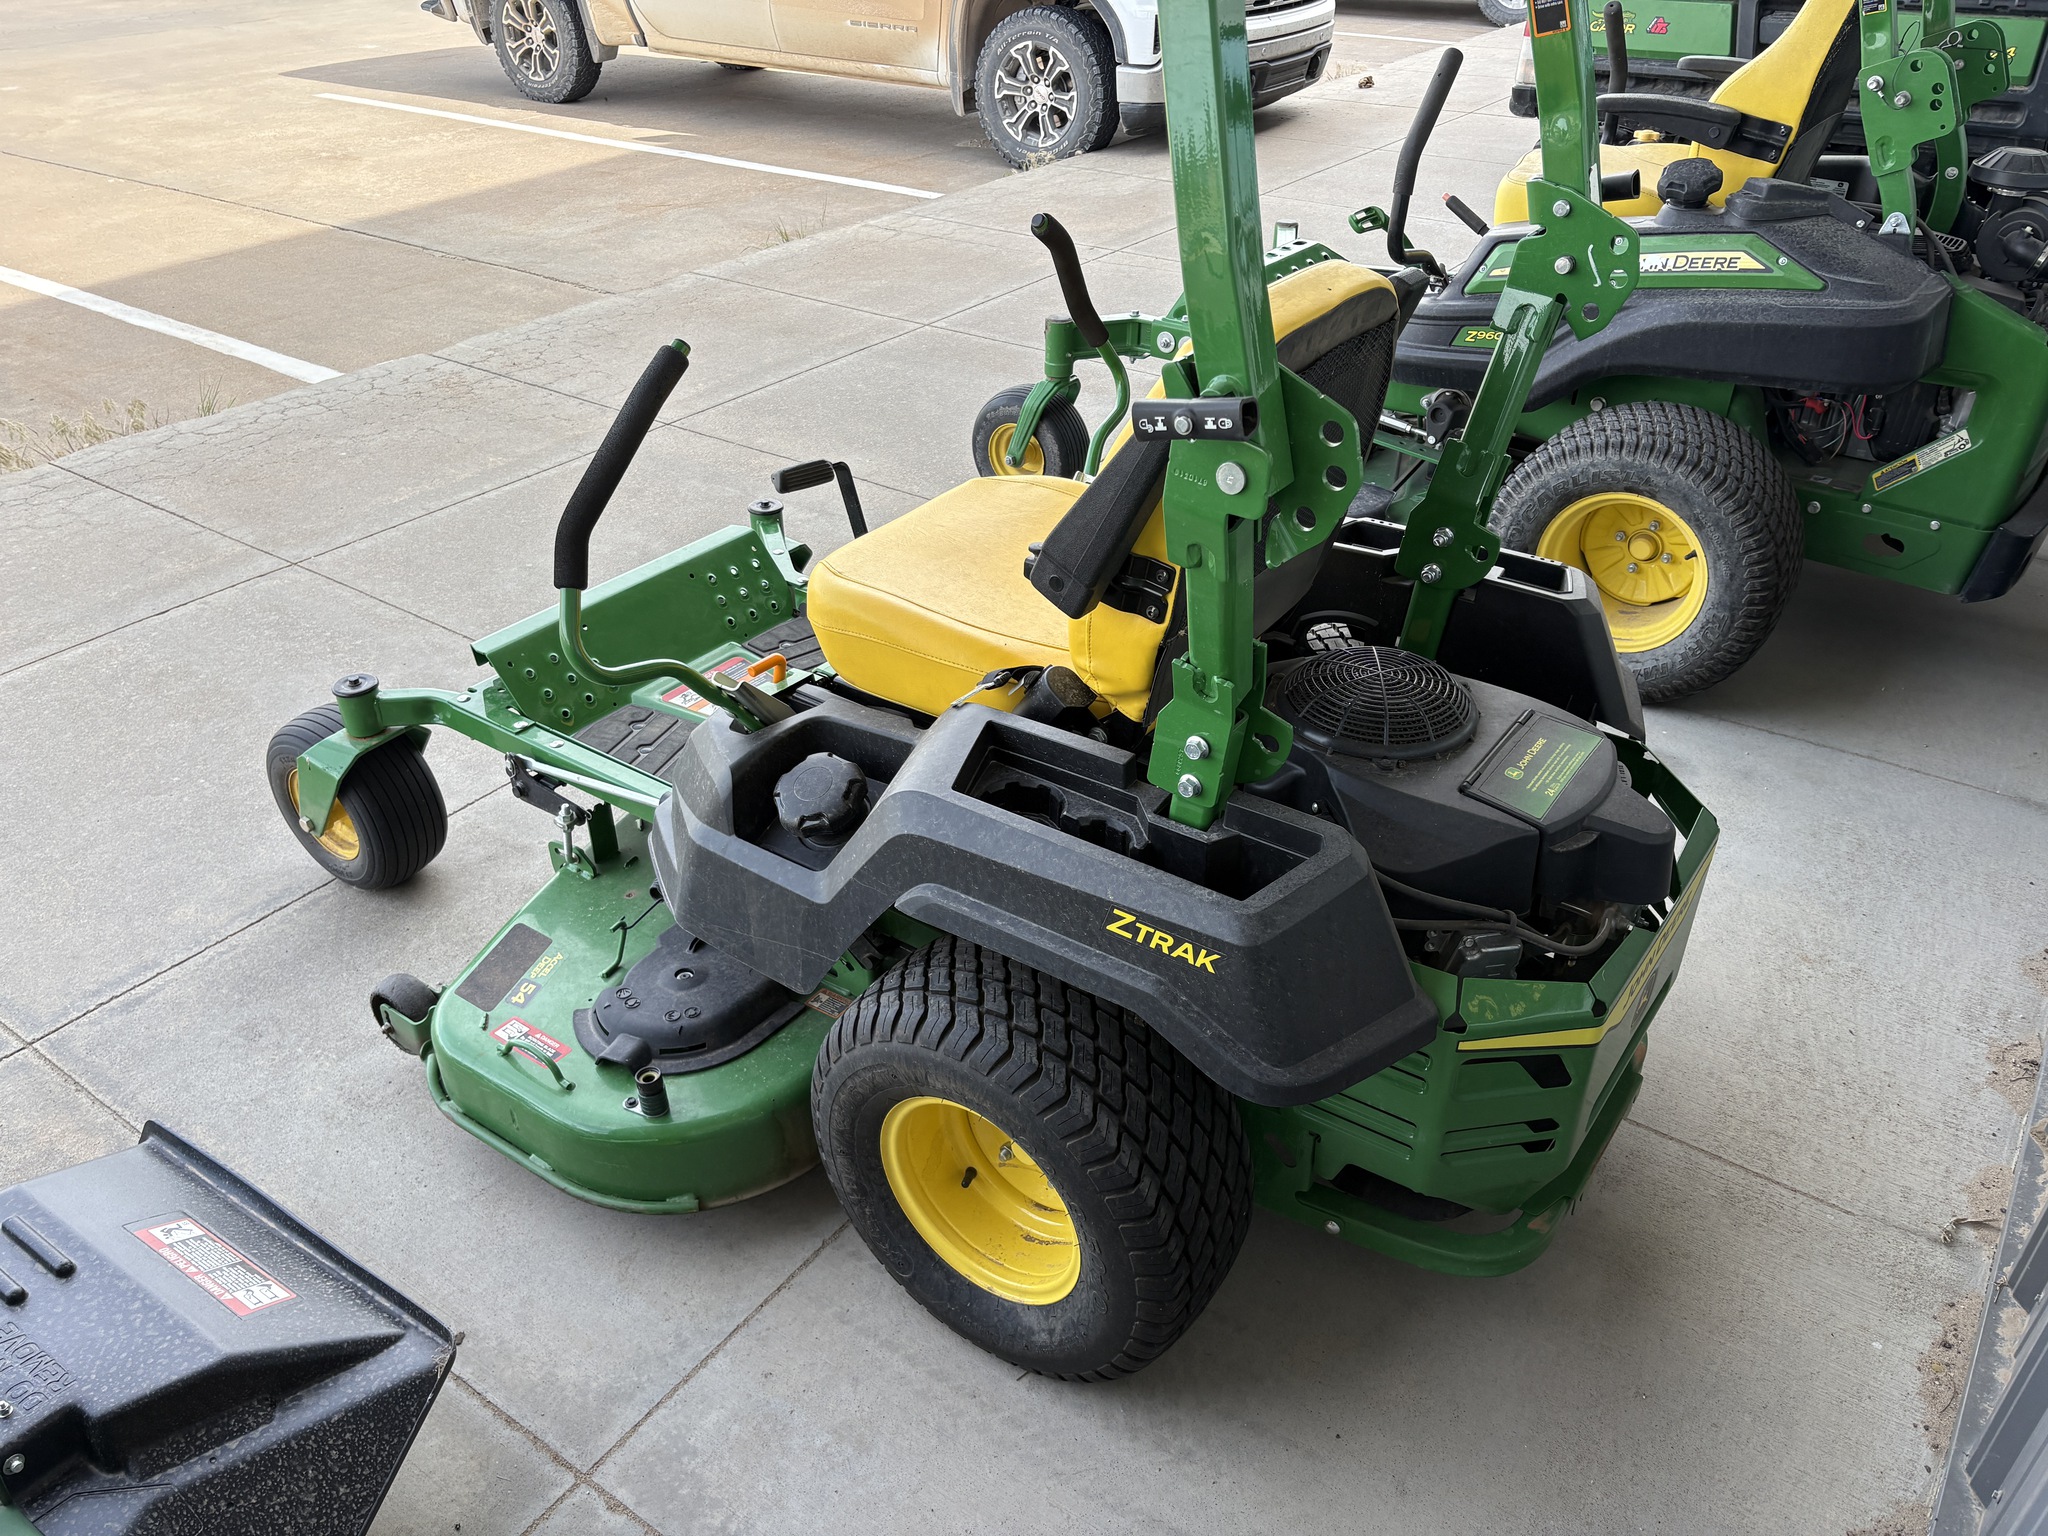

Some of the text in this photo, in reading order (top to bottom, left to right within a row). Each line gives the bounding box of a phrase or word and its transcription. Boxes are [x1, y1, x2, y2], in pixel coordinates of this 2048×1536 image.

[849, 20, 918, 33] SIERRA
[1672, 255, 1741, 270] DEERE
[1678, 614, 1729, 672] TURF
[1516, 754, 1533, 770] JOHN
[1527, 737, 1547, 755] DEERE
[1106, 908, 1221, 974] ZTRAK
[530, 955, 552, 979] DEEP
[538, 952, 564, 978] ACCEL
[511, 982, 537, 1004] 54
[540, 1034, 560, 1048] DANGER
[158, 1247, 189, 1273] PELIGRO
[193, 1272, 226, 1300] DANGER
